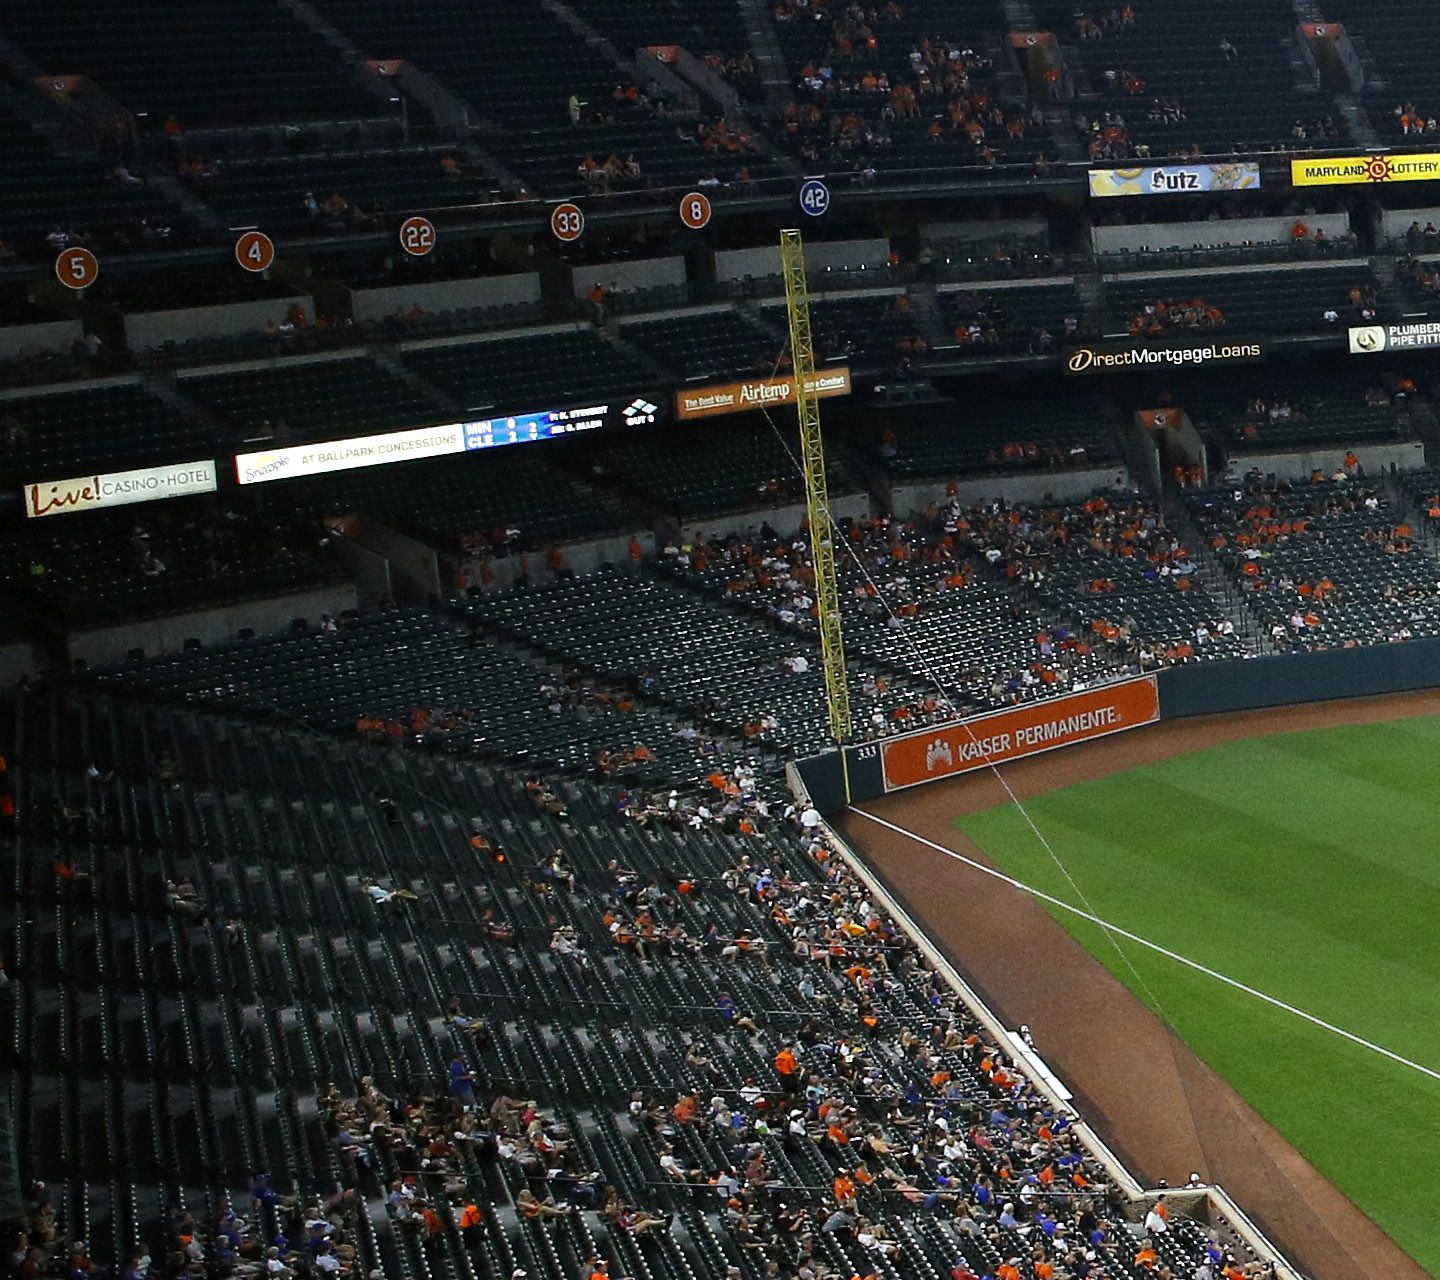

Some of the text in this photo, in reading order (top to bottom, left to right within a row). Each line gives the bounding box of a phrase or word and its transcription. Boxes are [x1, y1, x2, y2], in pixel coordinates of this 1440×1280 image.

[1306, 163, 1438, 178] MARYLAND LOTTERY
[804, 189, 827, 208] 42
[691, 202, 701, 220] 8
[556, 212, 580, 232] 33
[406, 226, 432, 247] 22
[246, 240, 263, 263] 4
[70, 256, 86, 280] 5
[1390, 335, 1415, 347] PIPE
[1069, 345, 1260, 371] DirectMortgageLoans
[739, 383, 790, 404] Airtemp
[465, 422, 492, 436] MIN
[302, 434, 457, 465] AT BALLPARK CONCESSIONS
[468, 434, 494, 449] CLE
[32, 477, 101, 516] Live!
[102, 477, 158, 496] CASINO
[167, 470, 210, 485] HOTEL
[958, 706, 1116, 762] KAISER PERMANENTE
[857, 745, 877, 761] 333
